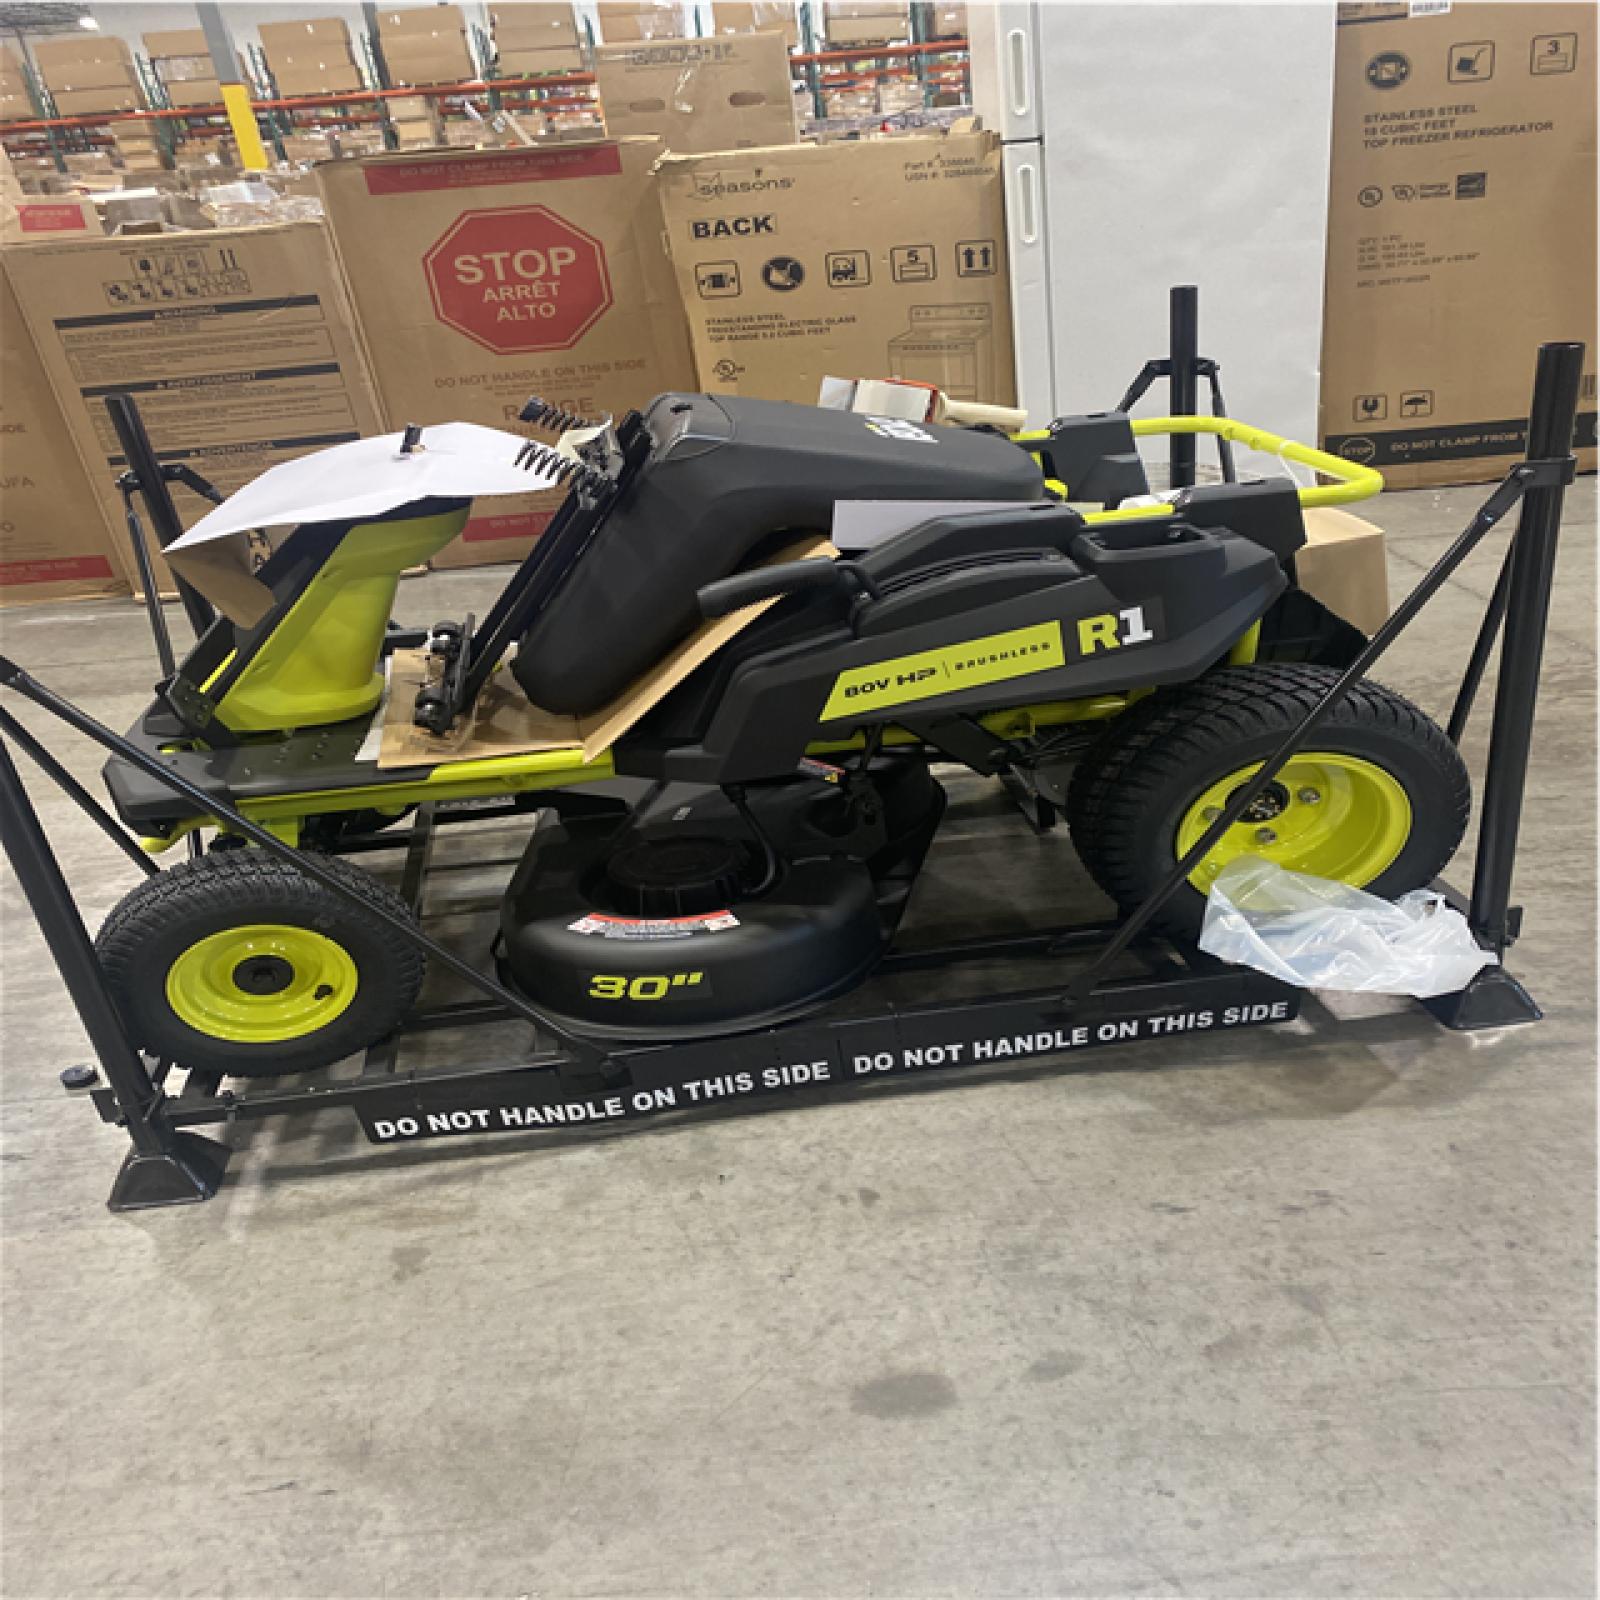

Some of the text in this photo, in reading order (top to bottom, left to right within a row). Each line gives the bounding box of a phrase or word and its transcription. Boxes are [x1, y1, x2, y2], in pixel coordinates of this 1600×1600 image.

[1548, 40, 1560, 55] 3
[1364, 104, 1478, 123] STAINLESS STEEL
[1363, 121, 1553, 149] TOP FREEZER REFRIGERATOR
[1380, 122, 1420, 136] CUBIC
[1425, 118, 1455, 129] FEET
[692, 215, 774, 239] BACK
[454, 246, 577, 285] STOP
[482, 279, 561, 304] ARRÊT
[497, 302, 557, 323] ALTO
[434, 377, 456, 389] DO
[460, 373, 487, 386] NOT
[492, 368, 550, 384] HANDLE
[554, 366, 576, 378] ON
[580, 362, 612, 374] THIS
[615, 359, 647, 371] SIDE
[1440, 436, 1481, 449] CLAMP
[1077, 605, 1153, 656] R1
[896, 667, 937, 686] HP
[954, 642, 1051, 671] BRUSHLESS
[853, 1001, 1290, 1075] DO NOT HANDLE ON THIS SIDE
[374, 1060, 832, 1140] DO NOT HANDLE ON THIS SIDE
